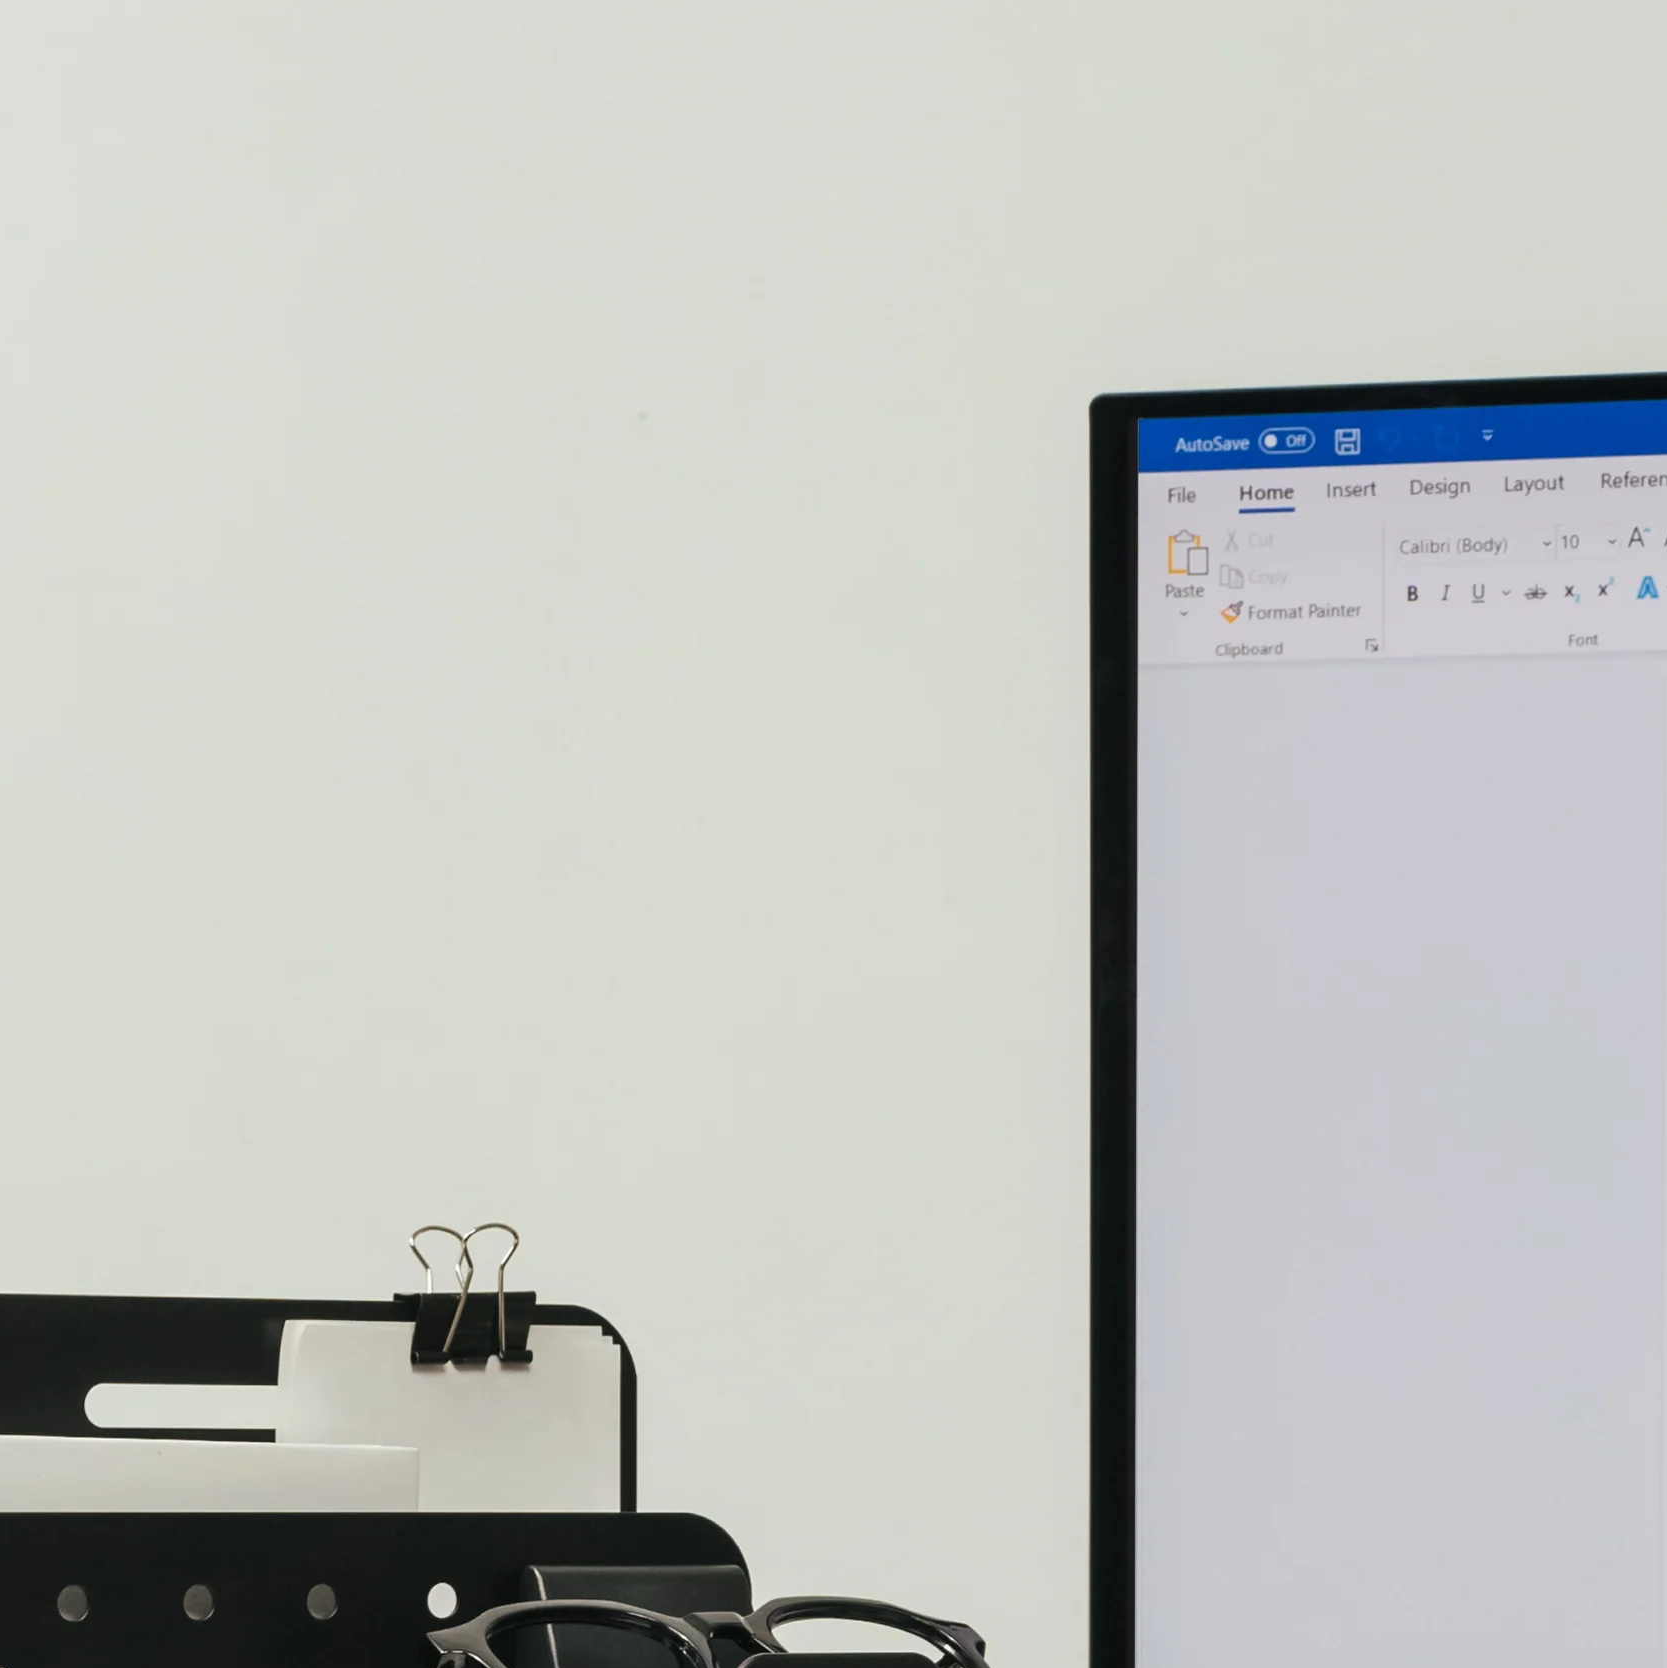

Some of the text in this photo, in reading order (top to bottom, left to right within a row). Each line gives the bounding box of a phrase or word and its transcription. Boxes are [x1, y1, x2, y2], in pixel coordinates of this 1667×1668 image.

[1175, 435, 1250, 454] AutoSave
[1286, 432, 1307, 448] Off
[1168, 487, 1196, 505] File
[1240, 483, 1295, 502] Home
[1326, 480, 1377, 499] Insert
[1409, 477, 1472, 498] Design
[1504, 473, 1565, 496] Layout
[1400, 535, 1509, 556] Calibri (Body)
[1561, 534, 1580, 551] 10
[1165, 584, 1205, 598] Paste
[1248, 603, 1362, 621] Format Painter
[1568, 632, 1599, 648] Font
[1215, 642, 1284, 659] Clipboard
